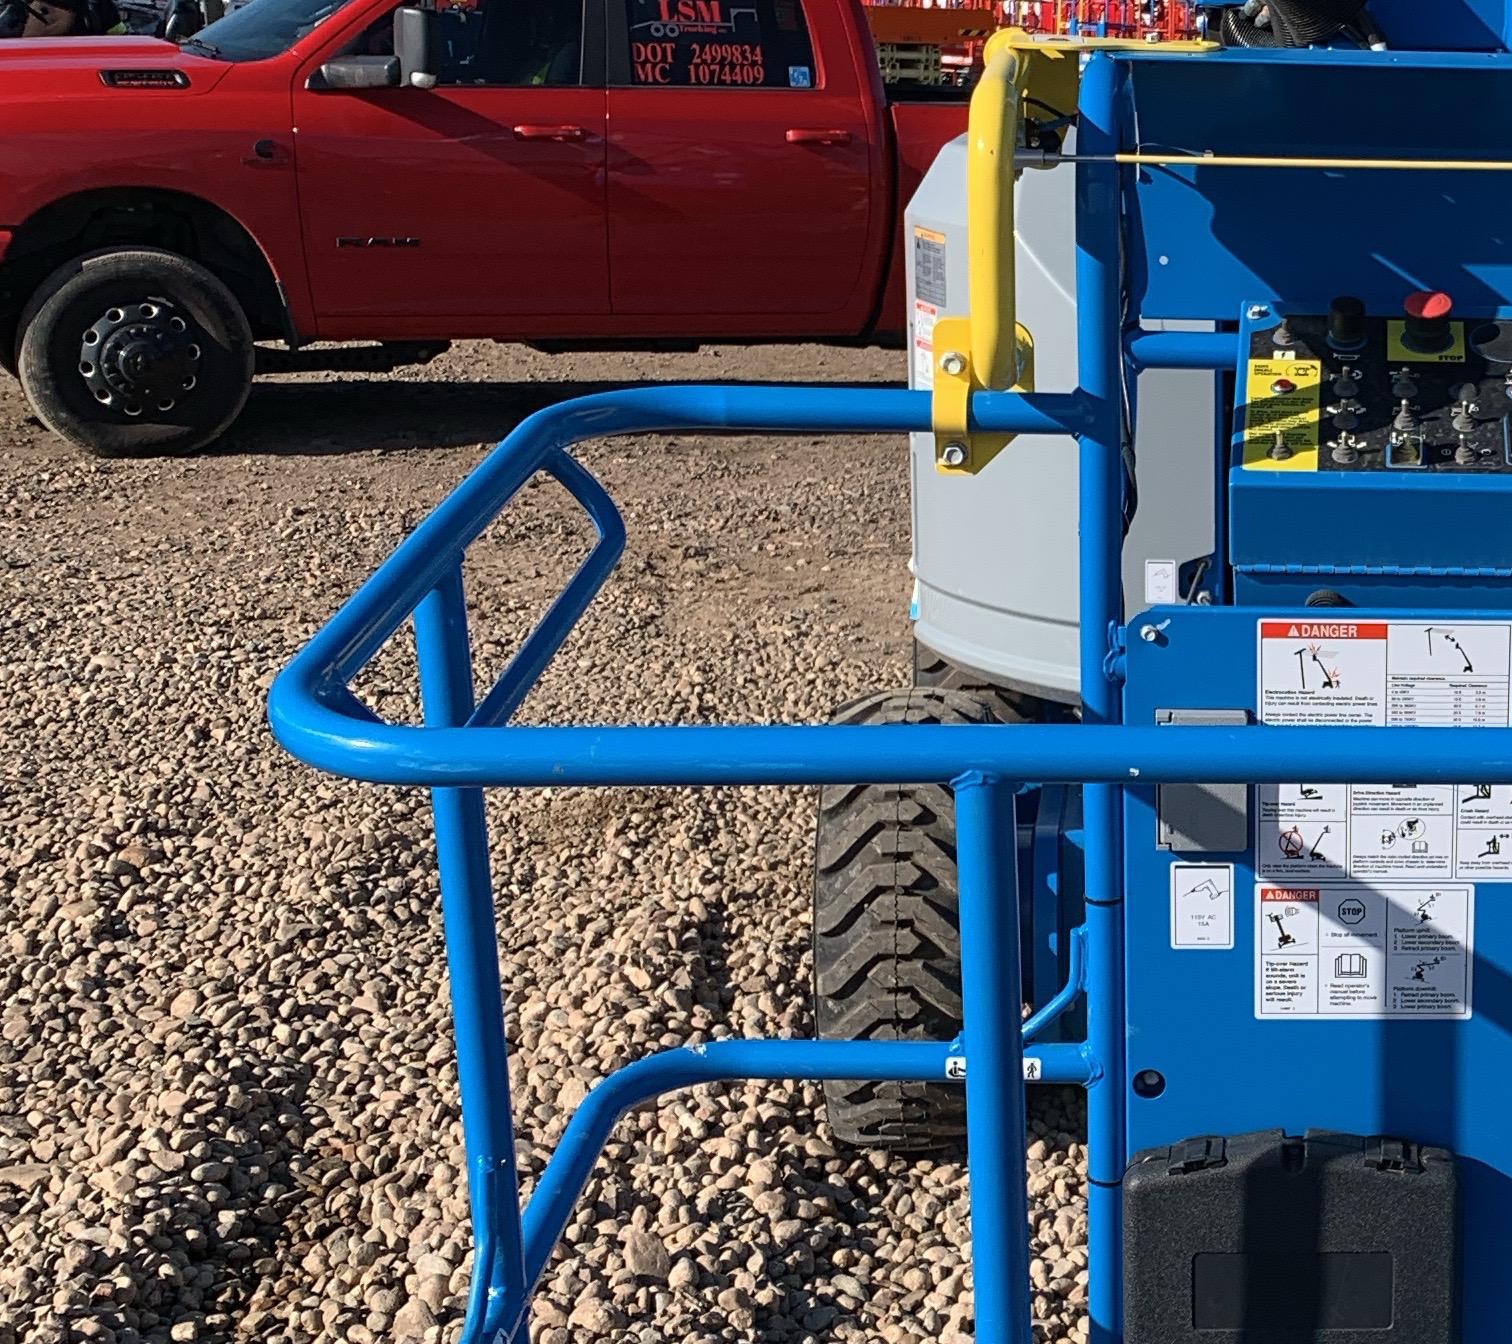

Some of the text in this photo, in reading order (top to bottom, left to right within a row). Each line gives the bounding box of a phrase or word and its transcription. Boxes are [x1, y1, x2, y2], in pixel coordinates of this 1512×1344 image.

[680, 24, 718, 34] Trucking
[631, 42, 763, 65] DOT 2499834
[632, 63, 765, 84] MC 1074409
[1301, 625, 1358, 637] DANGER
[1275, 890, 1316, 900] DANGER
[1341, 908, 1362, 916] STOP
